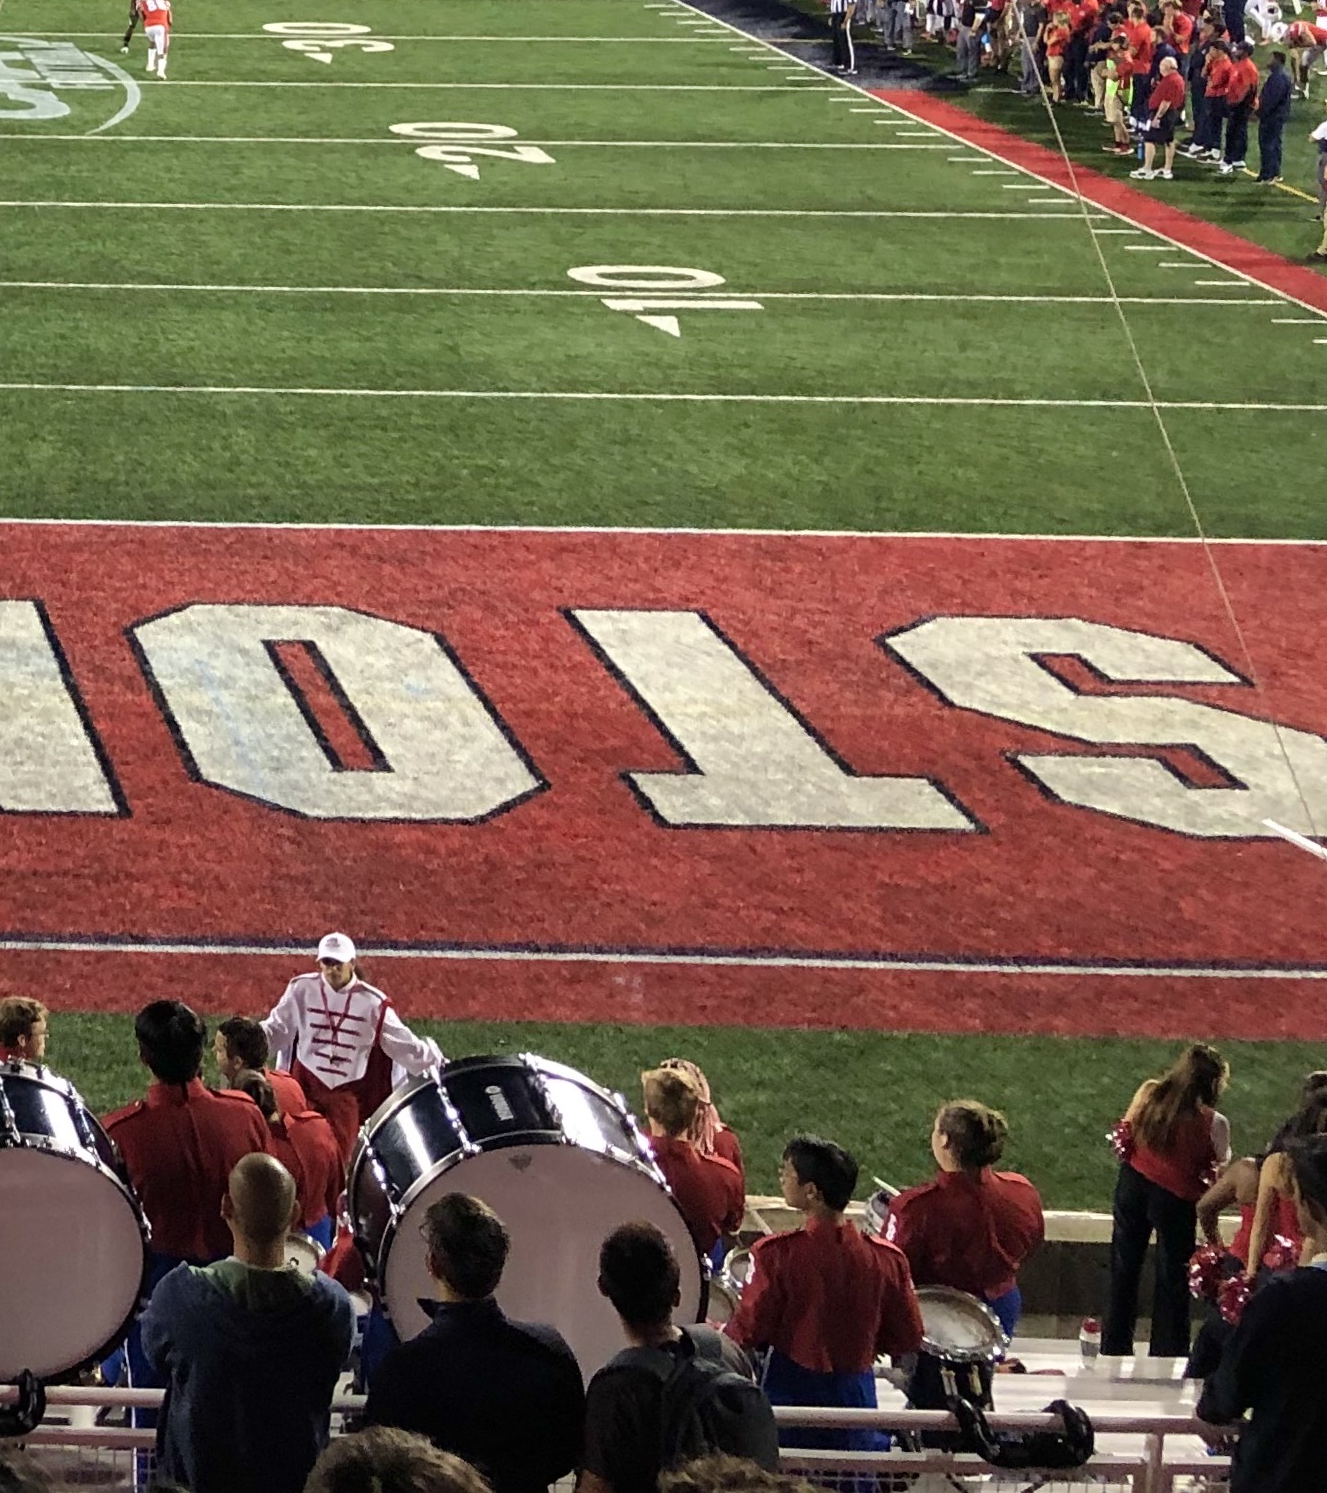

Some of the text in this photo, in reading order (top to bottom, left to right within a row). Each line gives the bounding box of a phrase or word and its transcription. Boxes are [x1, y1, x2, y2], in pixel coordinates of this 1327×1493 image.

[261, 21, 396, 53] 30
[387, 121, 557, 165] 20
[565, 263, 765, 311] 10
